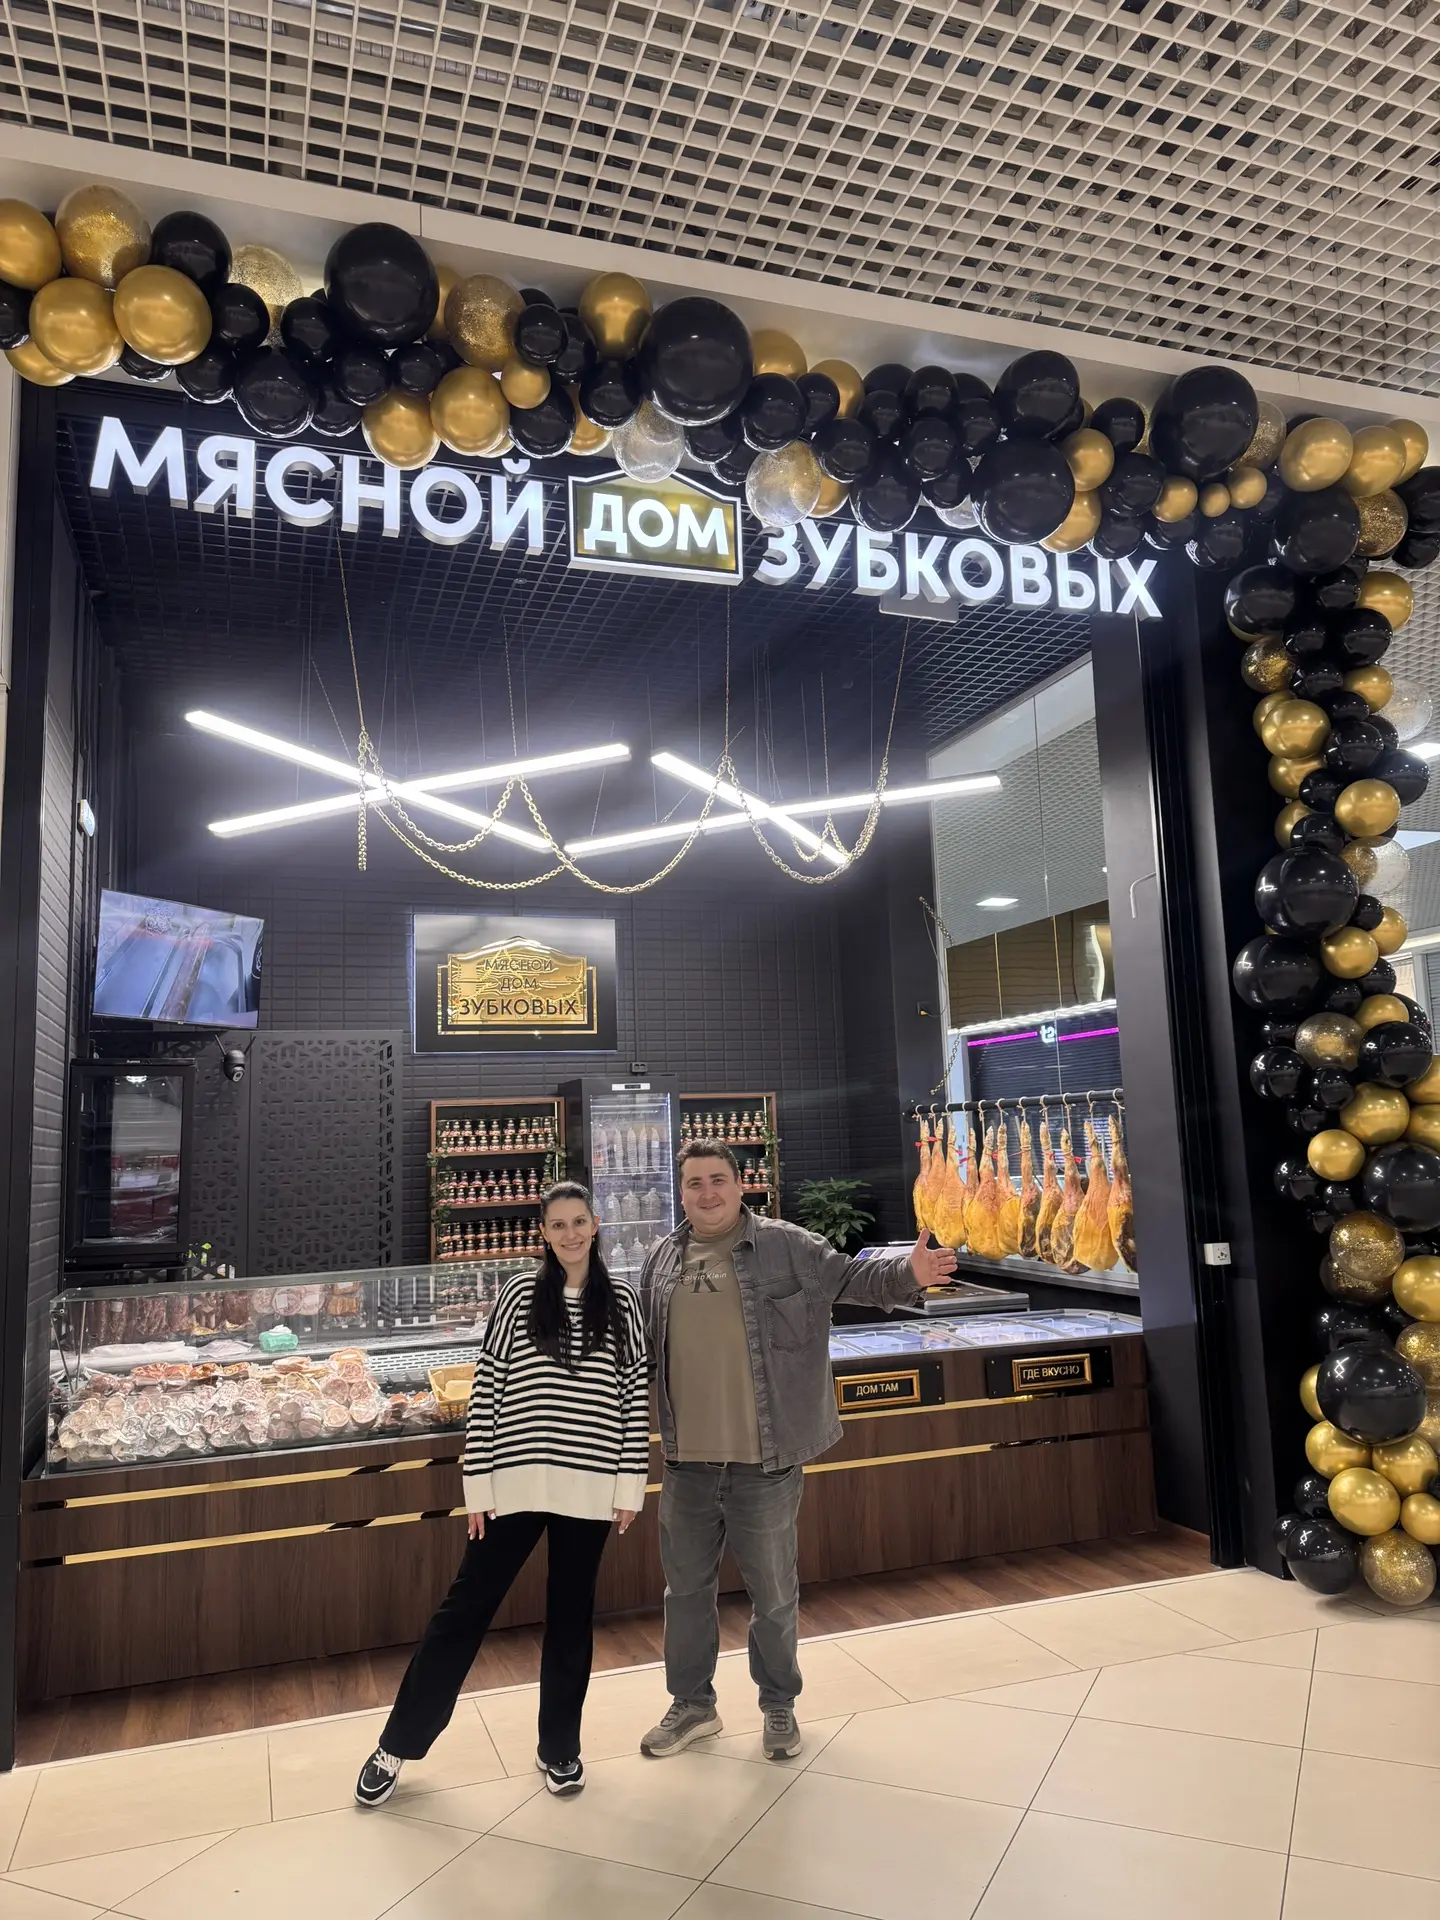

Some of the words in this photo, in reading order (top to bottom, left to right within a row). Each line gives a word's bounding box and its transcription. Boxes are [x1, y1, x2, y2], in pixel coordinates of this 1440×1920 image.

[89, 415, 546, 556] МЯСНОЙ
[583, 491, 730, 556] ДОМ
[753, 518, 1163, 618] ЗУБКОВЫХ
[500, 976, 538, 992] ДОМ
[459, 998, 578, 1016] ЗУБКОВЫХ
[678, 1273, 705, 1282] Calvin
[705, 1272, 728, 1281] Klein
[1022, 1368, 1041, 1380] ГДЕ
[1041, 1365, 1080, 1377] ВКУСНО
[856, 1384, 879, 1397] ДОМ
[879, 1382, 899, 1393] ТАМ
